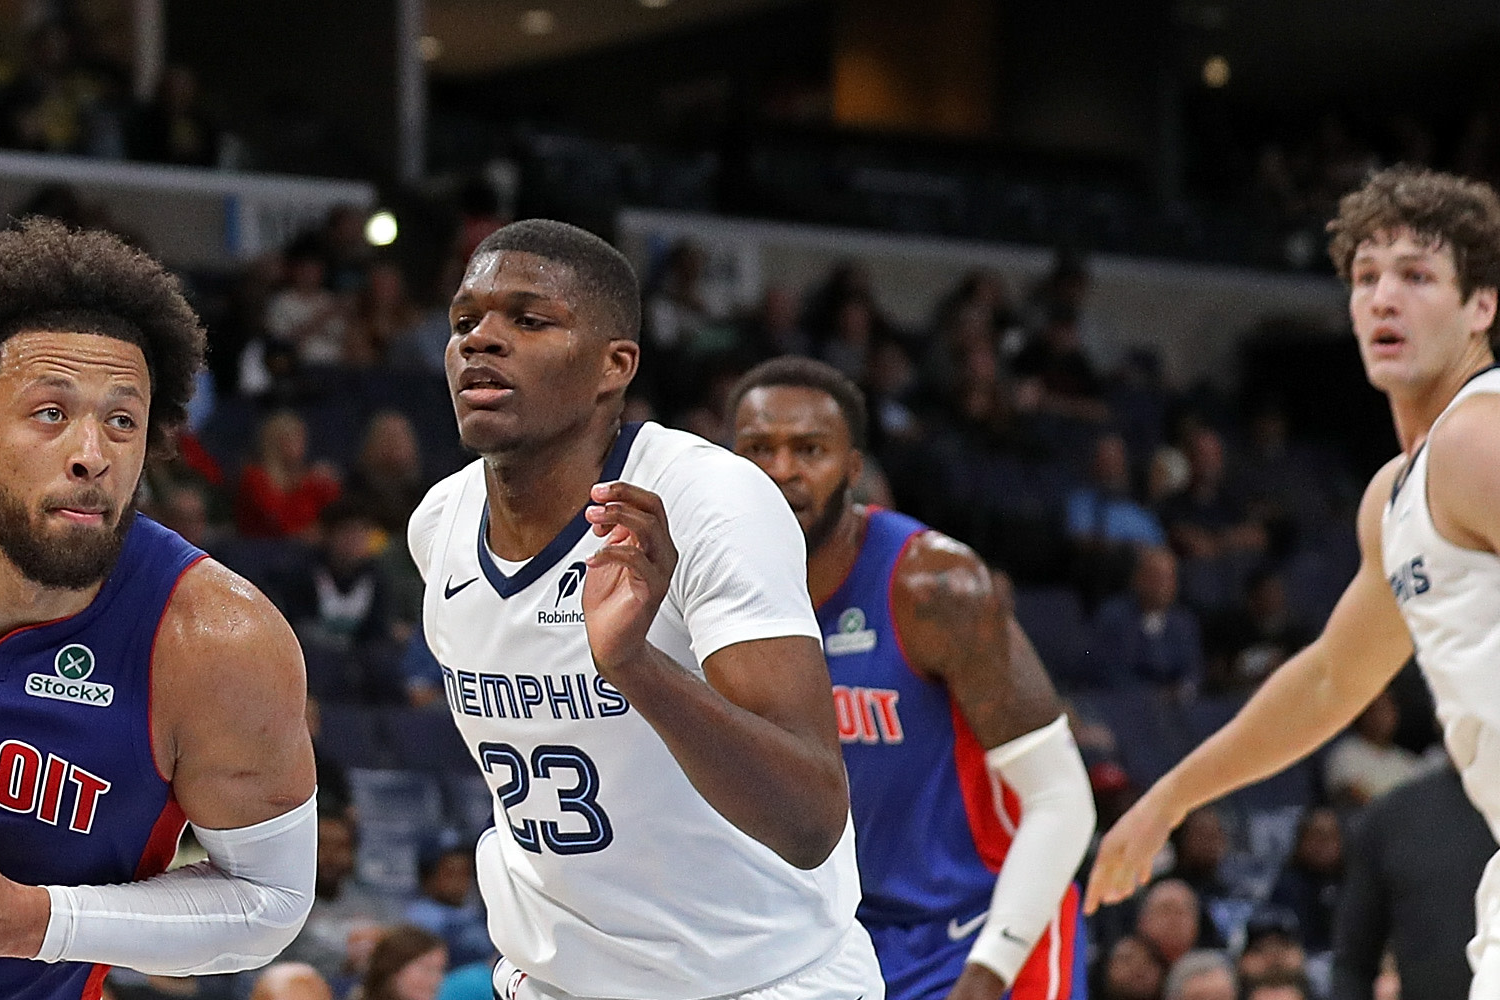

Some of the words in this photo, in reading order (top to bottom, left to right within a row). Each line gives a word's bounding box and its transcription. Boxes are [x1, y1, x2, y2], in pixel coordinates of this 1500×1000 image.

[537, 609, 586, 624] Robinho
[28, 675, 112, 704] StockX
[832, 685, 905, 745] OIT
[478, 741, 614, 856] 23
